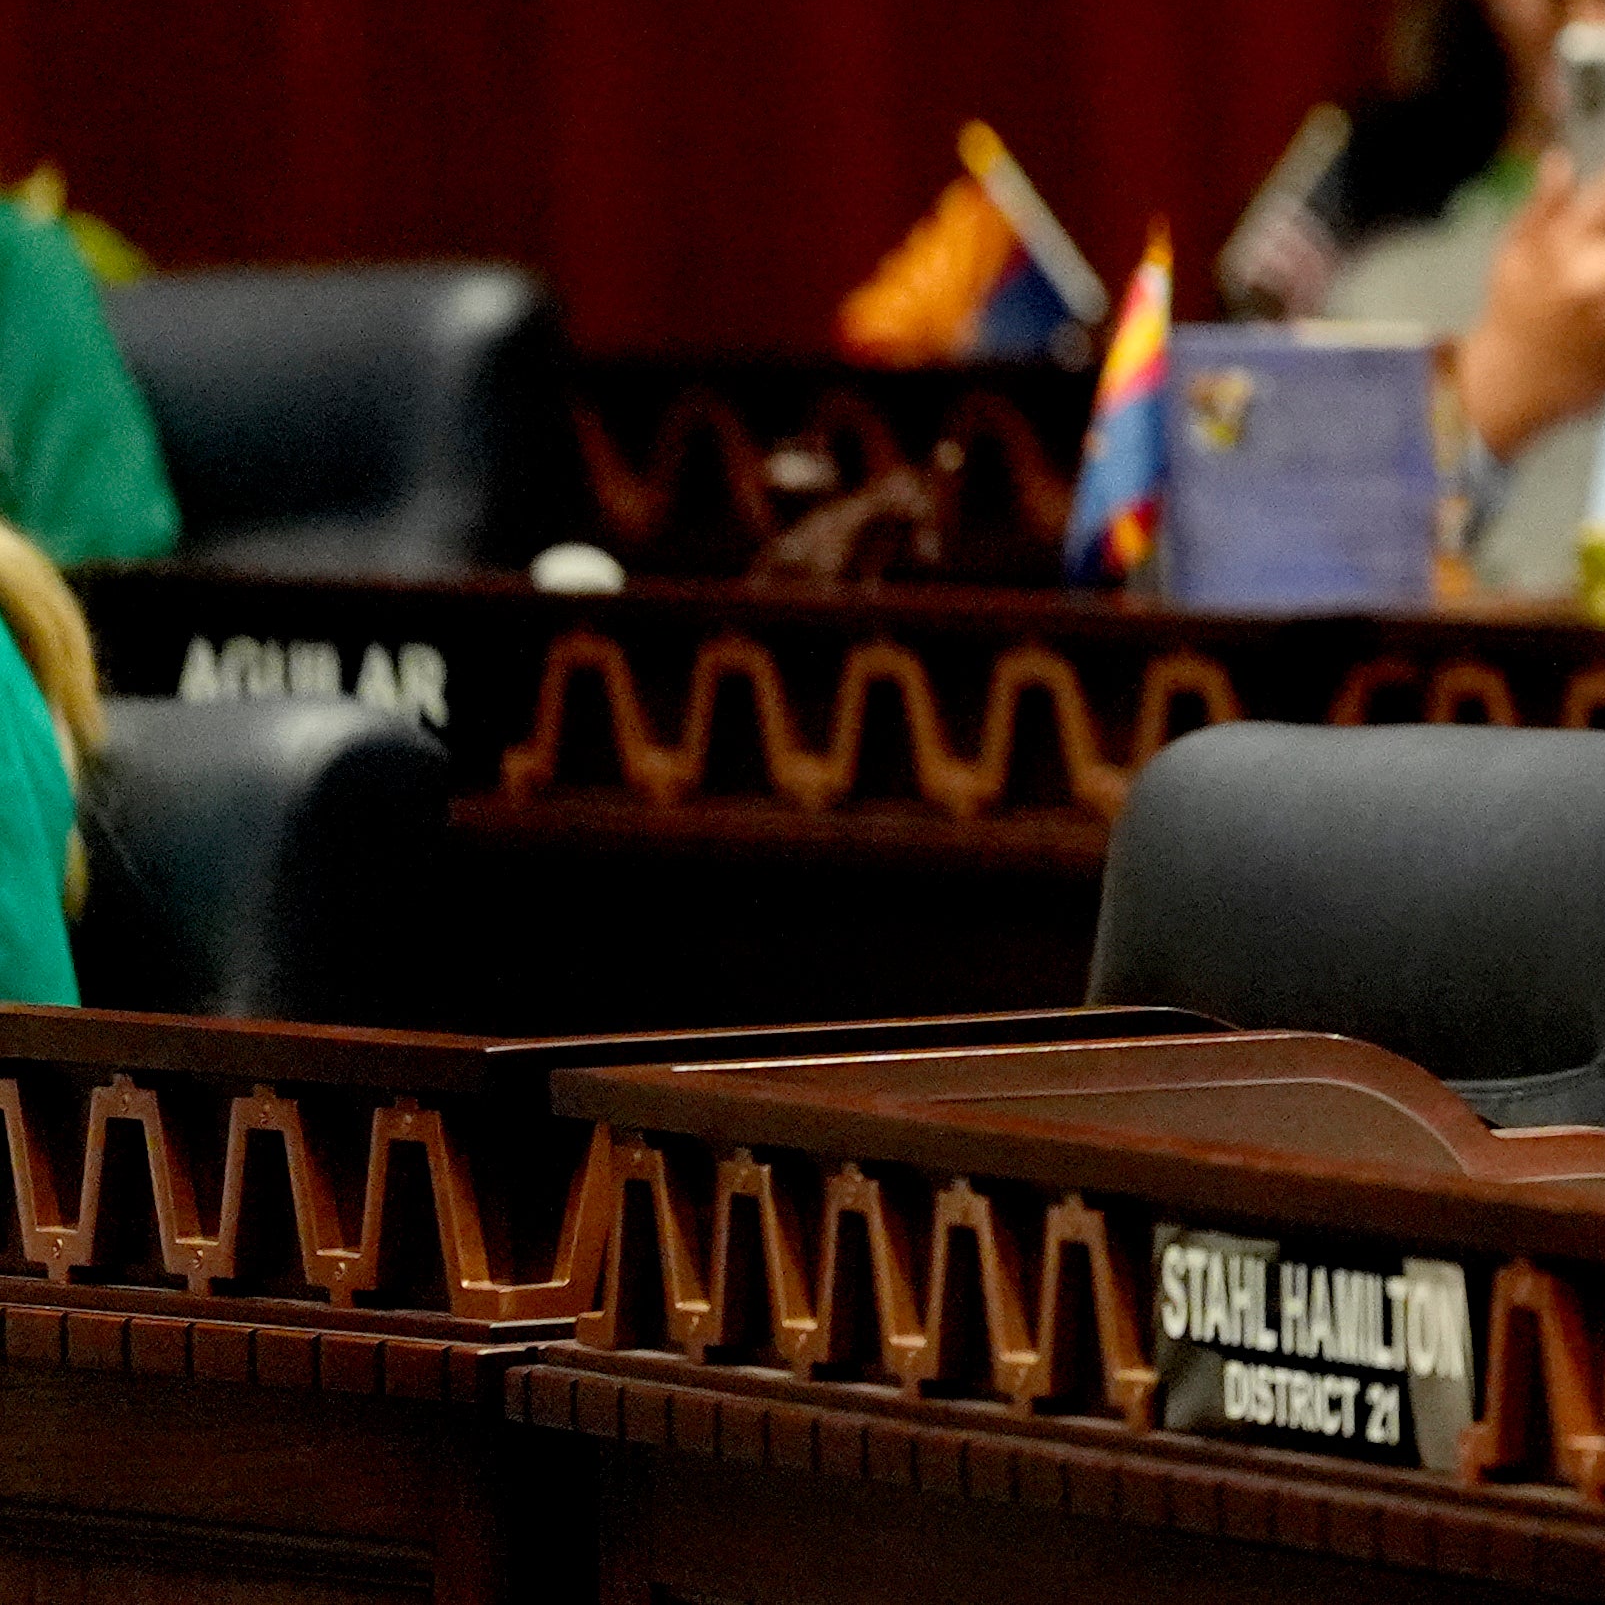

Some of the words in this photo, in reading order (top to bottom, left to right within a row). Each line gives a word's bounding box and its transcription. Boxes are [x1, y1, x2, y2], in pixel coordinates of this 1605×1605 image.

[1161, 1243, 1279, 1352] STAHL
[1279, 1260, 1466, 1380] HAMILTON
[1223, 1359, 1361, 1438] DISTRICT
[1365, 1381, 1401, 1446] 21
